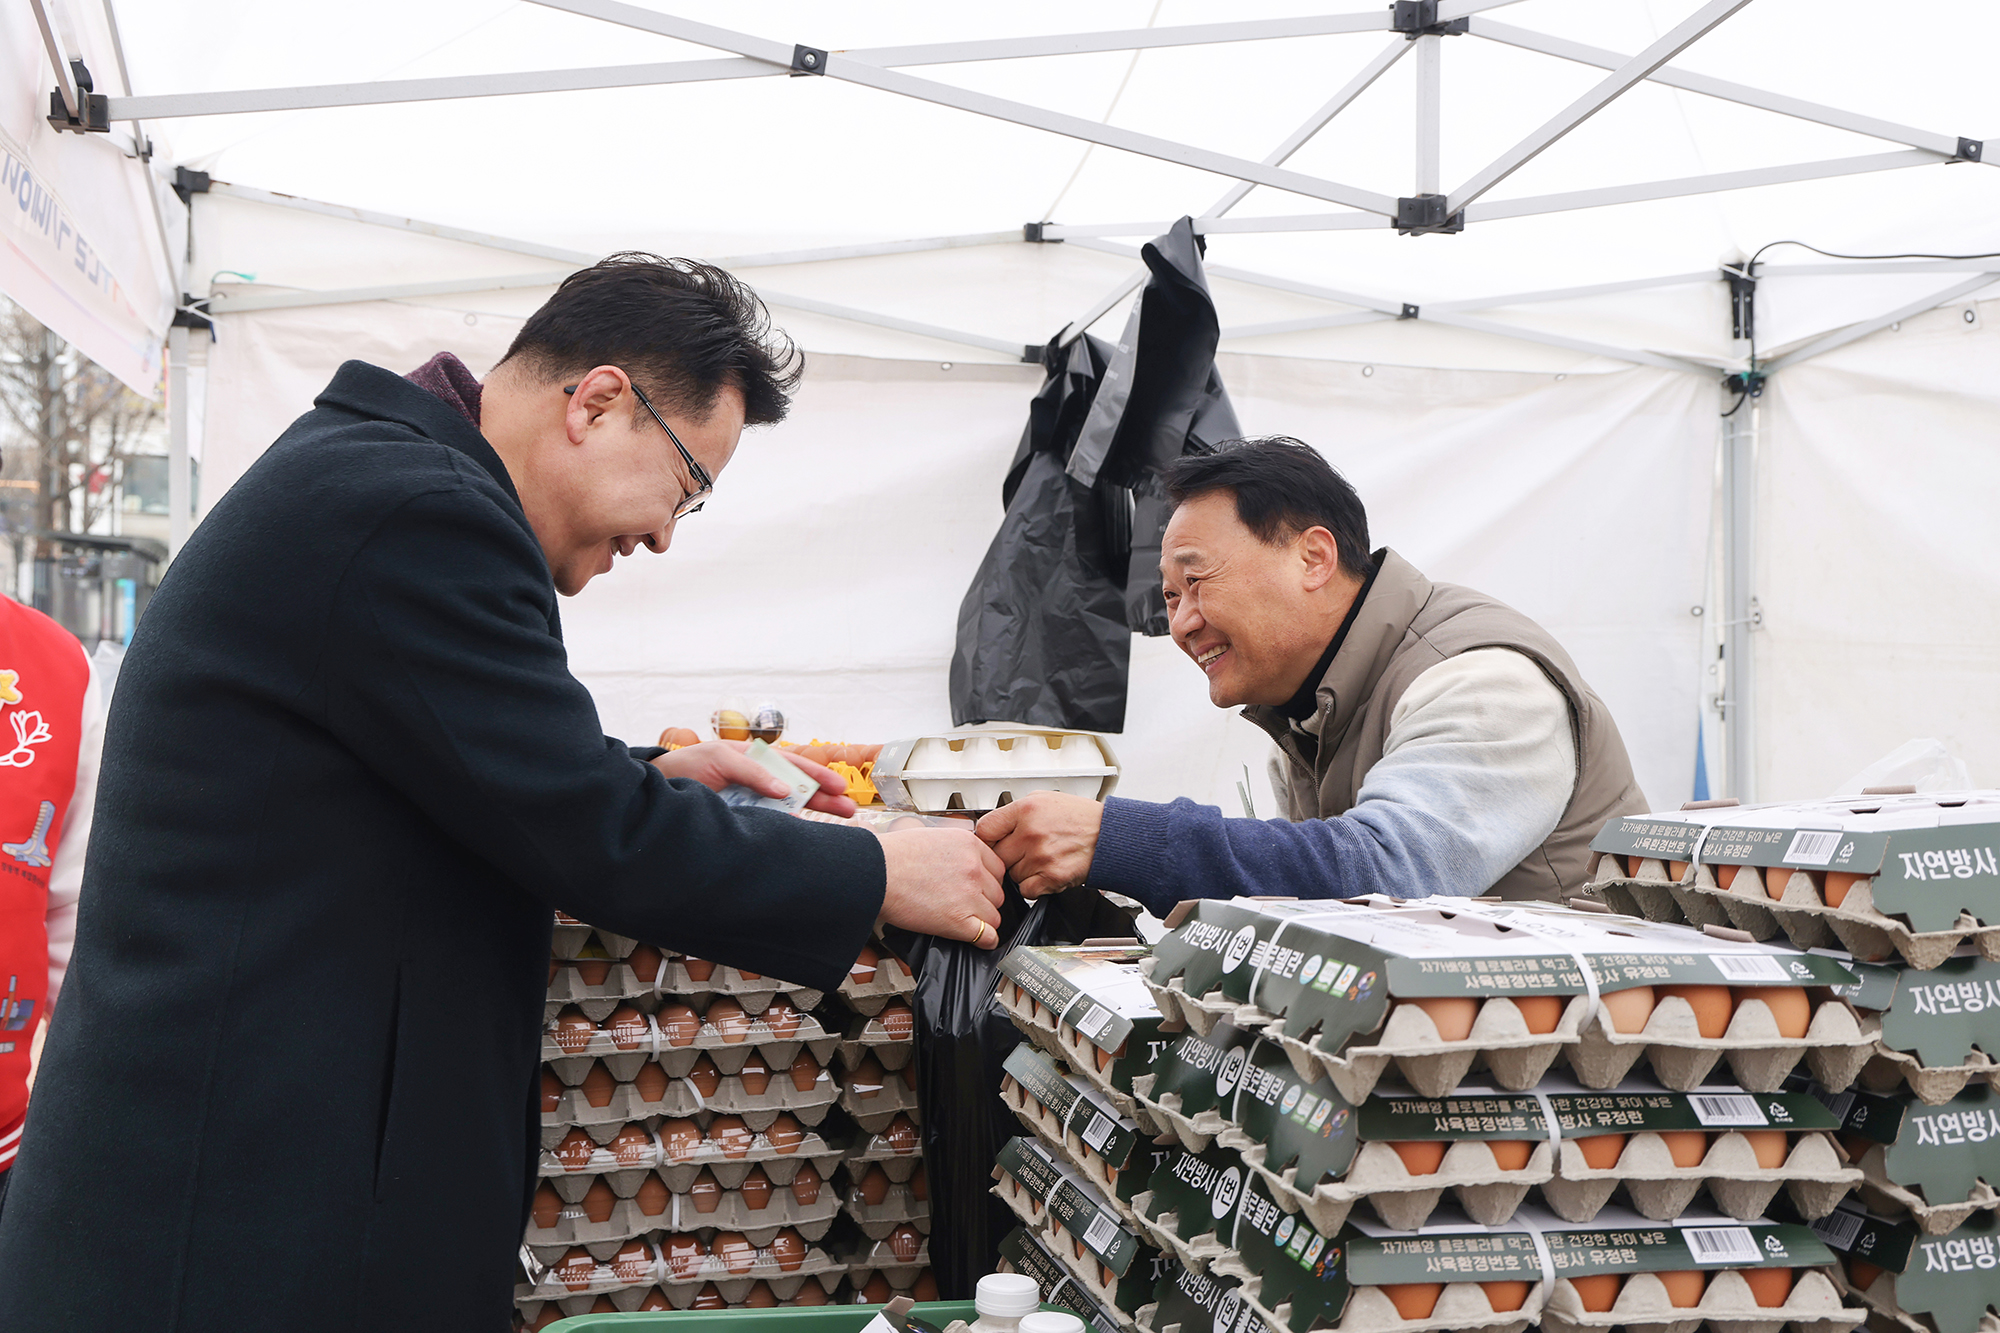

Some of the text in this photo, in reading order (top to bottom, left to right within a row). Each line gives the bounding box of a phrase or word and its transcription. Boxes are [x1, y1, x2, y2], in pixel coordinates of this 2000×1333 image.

[1619, 822, 1649, 834] 자가배양
[1649, 824, 1686, 837] 클로렐라를
[1721, 831, 1746, 842] 건강한
[1748, 832, 1764, 842] 닭이
[1766, 832, 1783, 844] 낳은
[1631, 837, 1684, 854] 사육환경번호
[1704, 843, 1722, 856] 방사
[1723, 845, 1753, 858] 유정란
[1899, 847, 1999, 881] 자연방사
[1180, 919, 1233, 955] 자연방사
[1248, 939, 1305, 979] 클로렐란
[1418, 960, 1472, 973] 자가배양
[1474, 958, 1540, 973] 클로렐라를
[1542, 957, 1570, 971] 먹고
[1601, 953, 1640, 966] 건강한
[1642, 954, 1667, 966] 닭이
[1669, 954, 1697, 966] 낳은
[1015, 970, 1041, 995] 사육환경번호
[1038, 986, 1048, 999] 1번
[1044, 992, 1058, 1006] 방사
[1017, 953, 1032, 970] 자가배양
[1030, 964, 1049, 982] 클로렐라를
[1046, 975, 1056, 987] 먹고
[1053, 980, 1064, 992] 자란
[1059, 985, 1075, 1001] 건강한
[1465, 973, 1558, 989] 사육환경번호
[1559, 972, 1586, 988] 1번
[1622, 965, 1672, 981] 유정란
[1176, 1036, 1224, 1075] 자연방사
[1240, 1063, 1286, 1106] 클로렐란
[1021, 1071, 1048, 1100] 사육환경번호
[1044, 1091, 1055, 1105] 1번
[1050, 1097, 1065, 1117] 방사
[1033, 1063, 1052, 1084] 클로렐라를
[1050, 1077, 1060, 1089] 먹고
[1056, 1083, 1067, 1097] 자란
[1080, 1106, 1092, 1119] 낳은
[1389, 1101, 1442, 1114] 자가배양
[1446, 1100, 1512, 1114] 클로렐라를
[1514, 1099, 1542, 1112] 먹고
[1575, 1097, 1614, 1110] 건강한
[1616, 1097, 1643, 1109] 닭이
[1645, 1097, 1673, 1109] 낳은
[1434, 1115, 1529, 1133] 사육환경번호
[1558, 1112, 1592, 1131] 방사
[1596, 1110, 1645, 1127] 유정란
[1015, 1144, 1031, 1163] 자가배양
[1029, 1155, 1050, 1178] 클로렐라를
[1047, 1171, 1058, 1185] 먹고
[1061, 1186, 1076, 1203] 건강한
[1073, 1195, 1084, 1208] 닭이
[1081, 1203, 1093, 1217] 낳은
[1171, 1151, 1219, 1195] 자연방사
[1017, 1164, 1046, 1194] 사육환경번호
[1058, 1201, 1074, 1221] 유정란
[1380, 1239, 1435, 1254] 자가배양
[1438, 1237, 1504, 1253] 클로렐라를
[1506, 1236, 1534, 1251] 먹고
[1568, 1233, 1608, 1247] 건강한
[1610, 1232, 1638, 1246] 닭이
[1639, 1231, 1667, 1245] 낳은
[1426, 1254, 1522, 1273] 사육환경번호
[1553, 1251, 1586, 1270] 방사
[1591, 1247, 1638, 1265] 유정란
[1920, 1235, 2000, 1273] 자연방
[1018, 1235, 1033, 1255] 자가배양
[1030, 1250, 1050, 1273] 클로렐라를
[1048, 1267, 1059, 1282] 먹고
[1061, 1283, 1076, 1301] 건강한
[1080, 1302, 1092, 1317] 낳은
[1044, 1281, 1054, 1296] 1번
